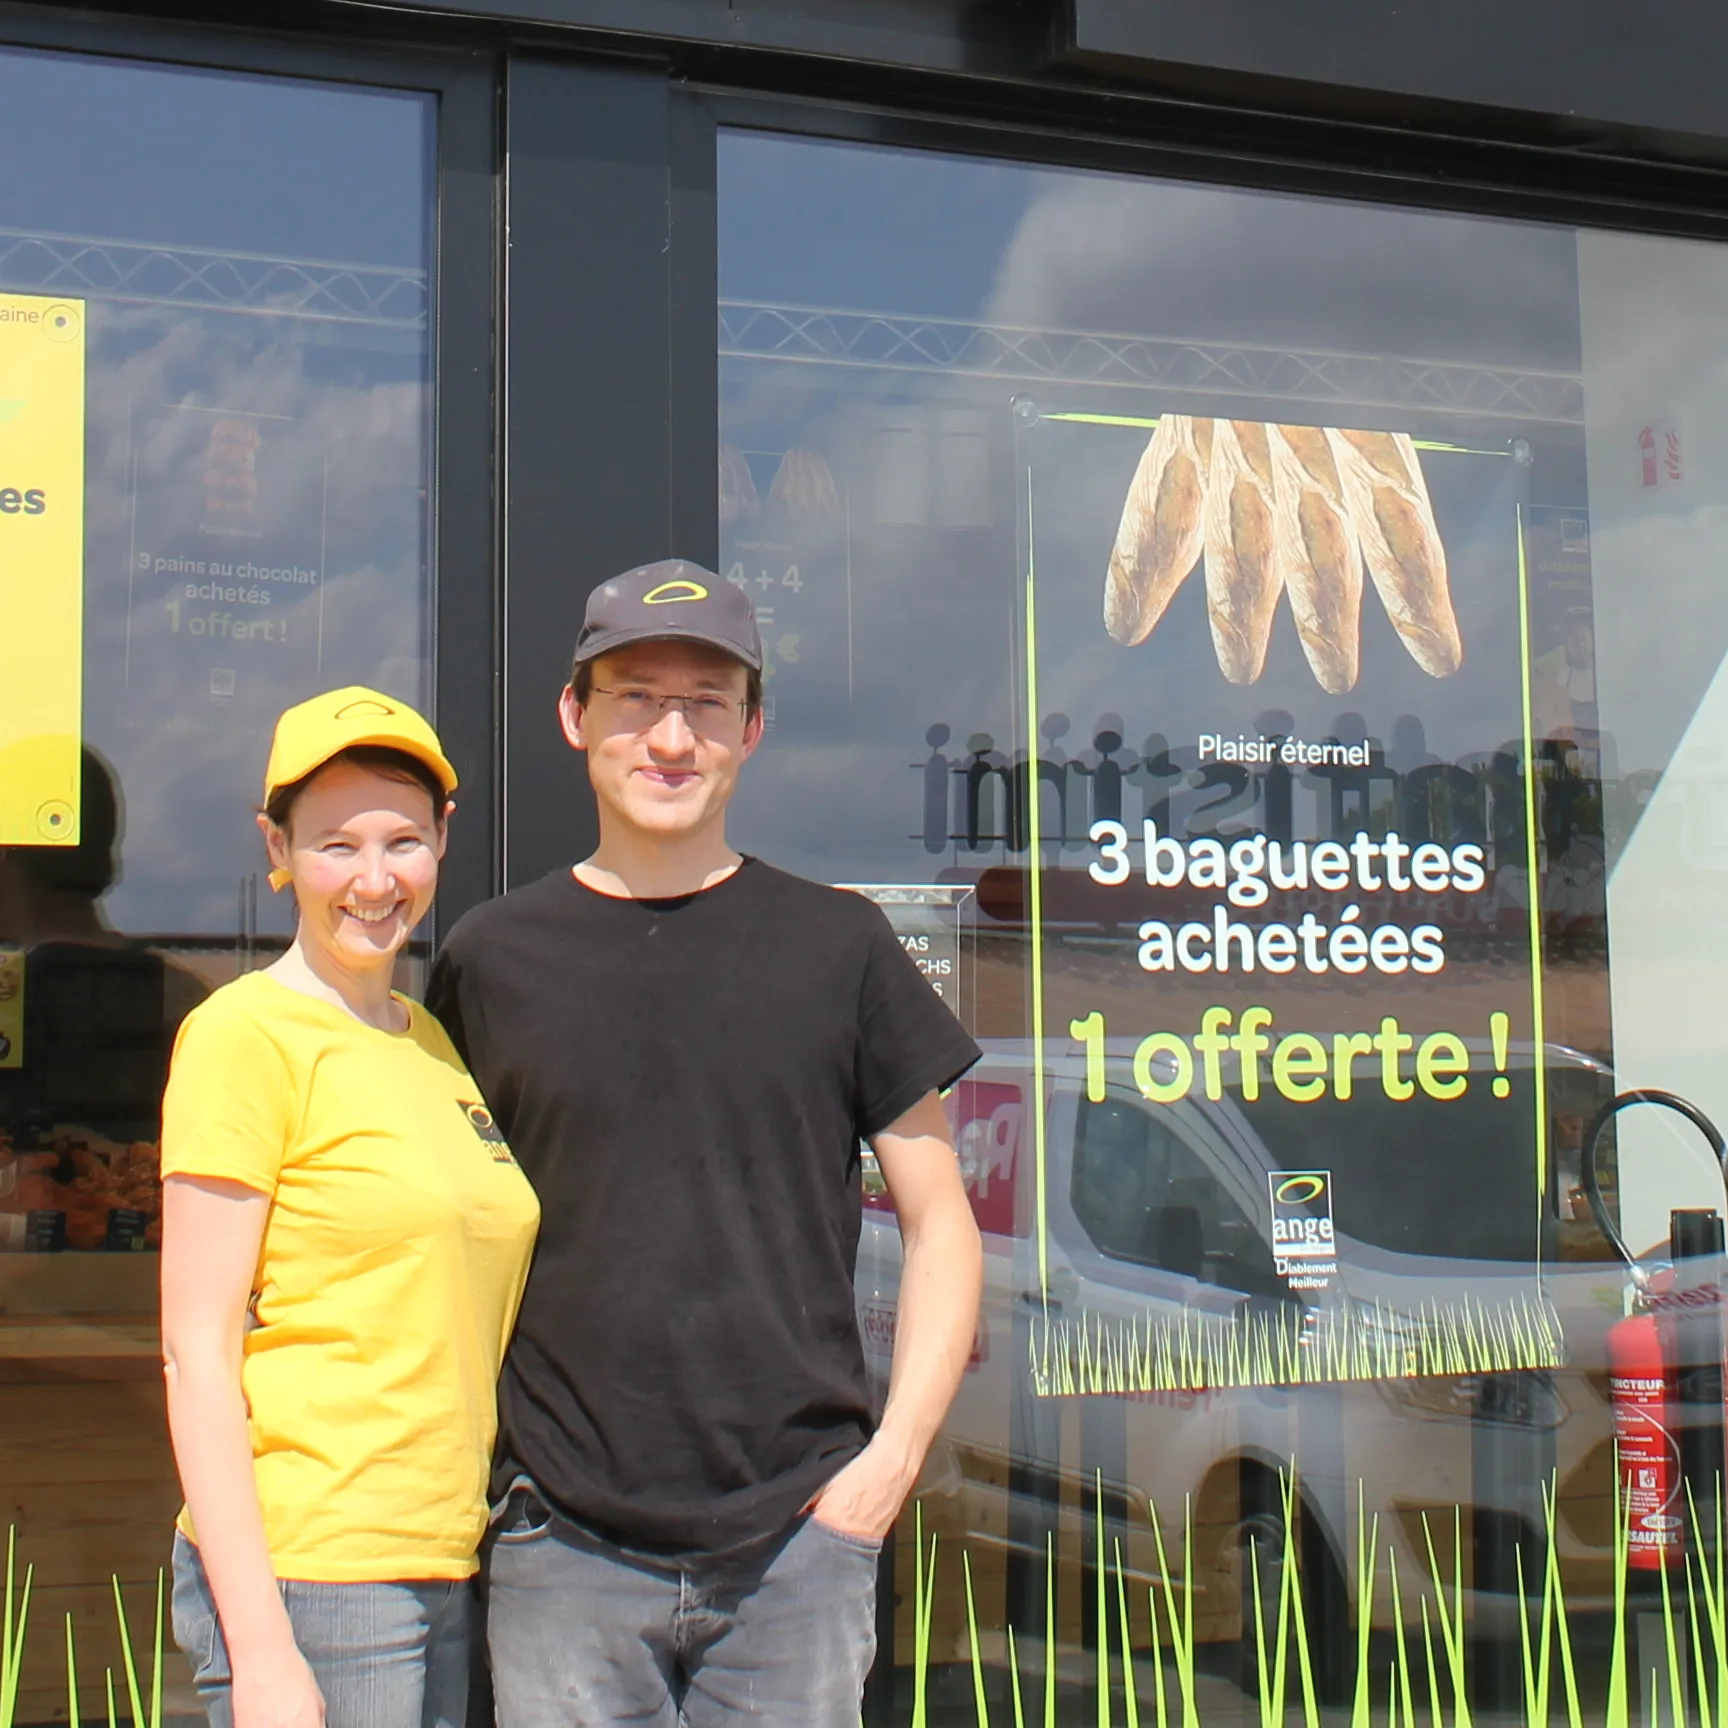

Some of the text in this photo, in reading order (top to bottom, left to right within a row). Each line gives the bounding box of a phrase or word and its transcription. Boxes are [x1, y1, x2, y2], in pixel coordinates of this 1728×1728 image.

[138, 552, 318, 585] 3 pains au chocolat
[184, 580, 272, 606] achetés
[188, 612, 276, 643] offert
[1198, 734, 1372, 767] Plaisir éternel
[1087, 818, 1487, 907] 3 baguettes
[1137, 903, 1446, 974] achetées
[1069, 1010, 1109, 1103] 1
[1133, 1006, 1470, 1103] offerte
[1273, 1217, 1333, 1245] ange
[1274, 1257, 1338, 1276] Diablement
[1288, 1276, 1329, 1290] Meilleur
